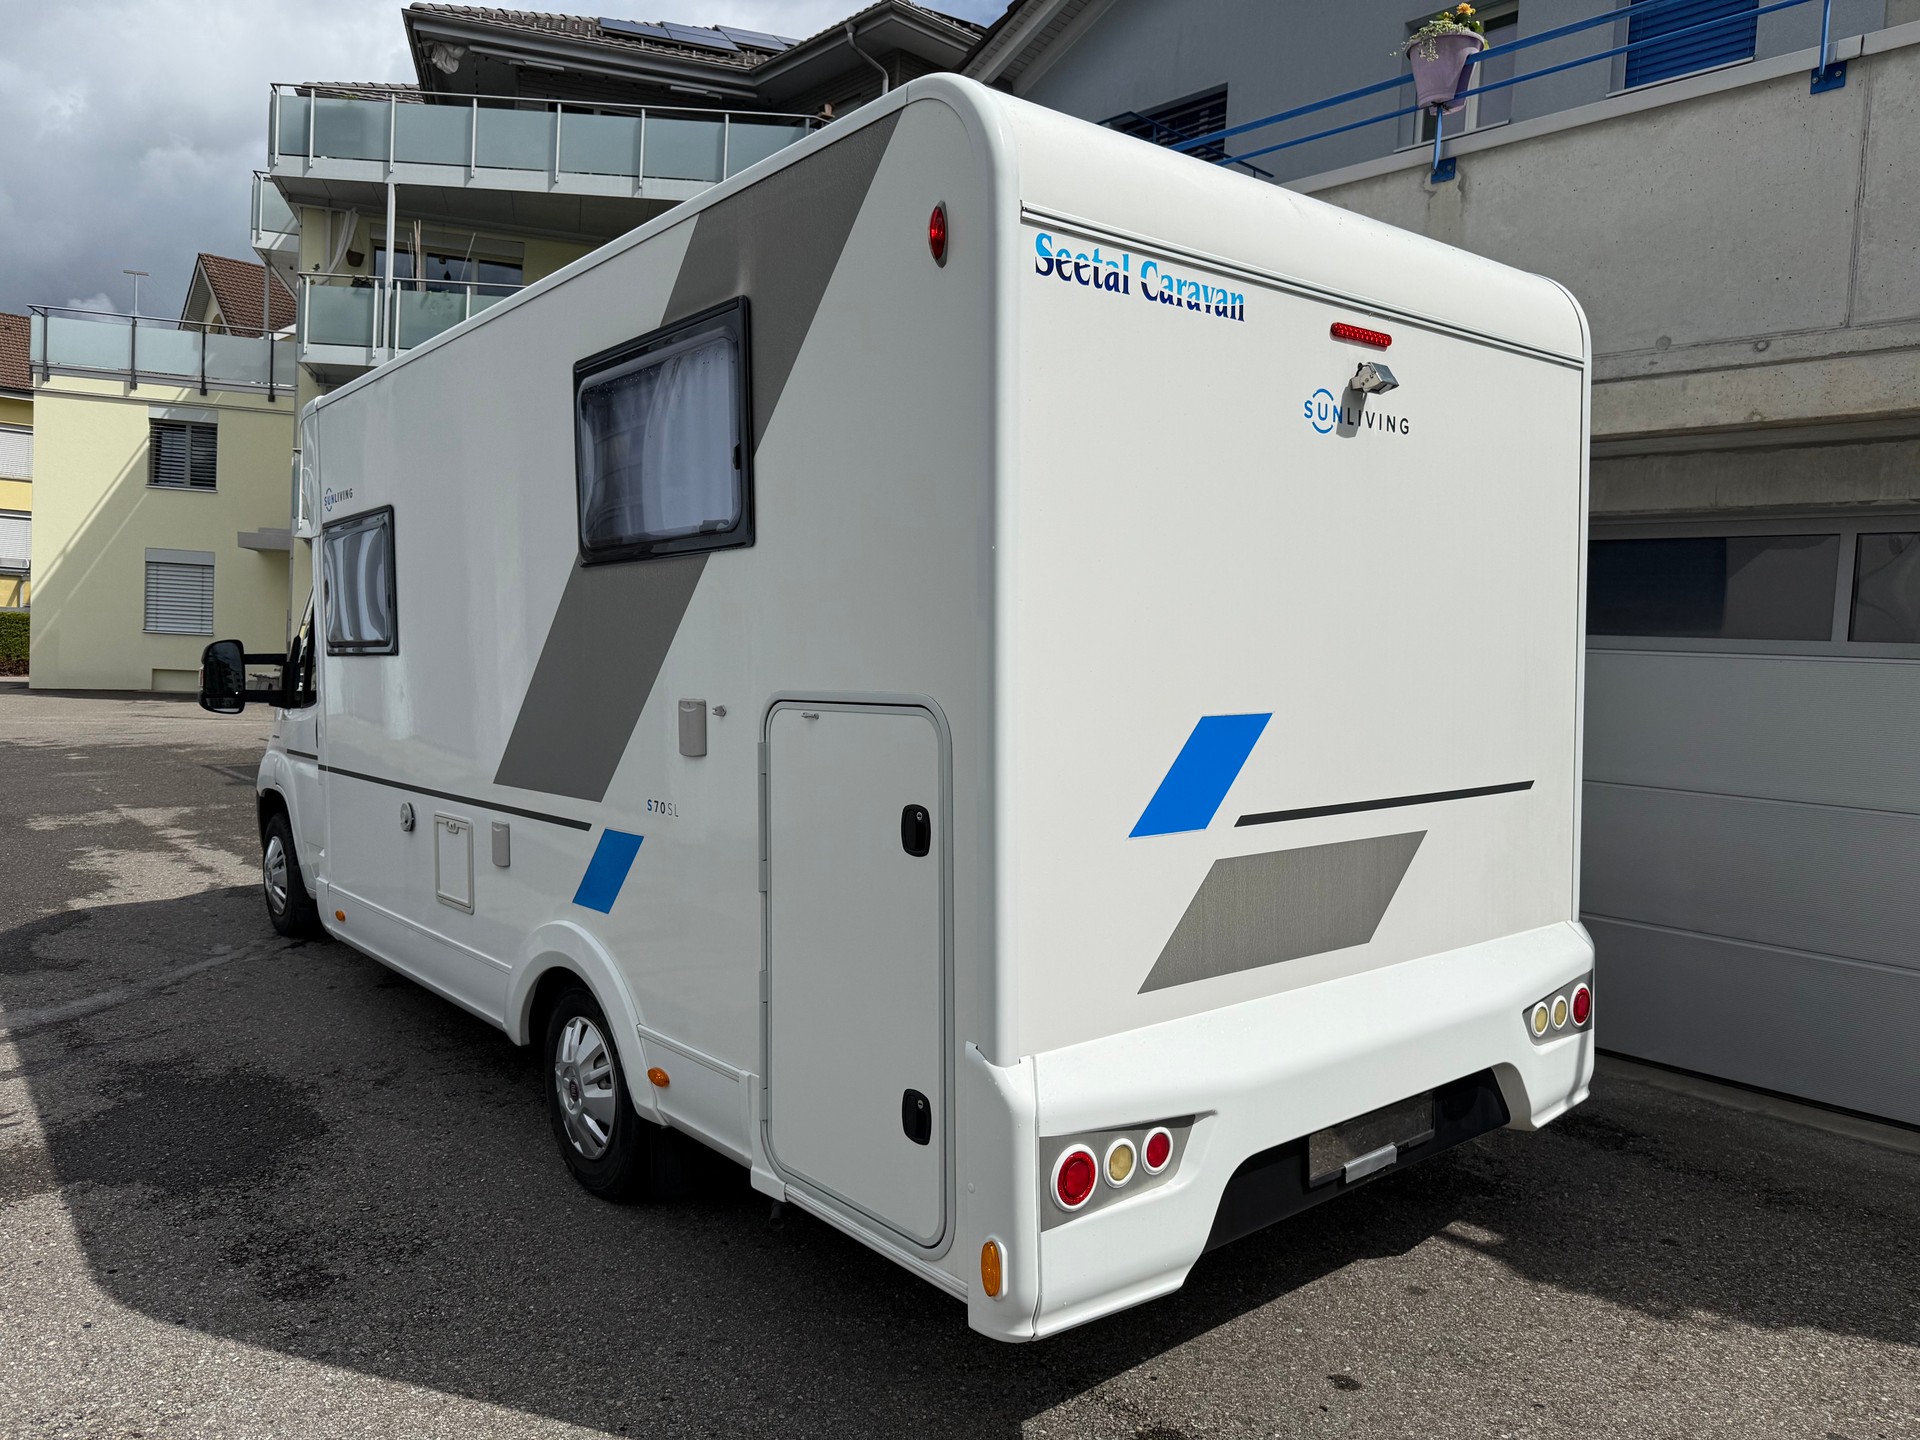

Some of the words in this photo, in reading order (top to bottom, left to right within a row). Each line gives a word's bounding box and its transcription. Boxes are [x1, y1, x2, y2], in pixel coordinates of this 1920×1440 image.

[1035, 232, 1130, 295] Seetal
[1140, 260, 1245, 322] Caravan
[1303, 399, 1410, 435] SUNLIVING
[324, 488, 353, 507] SUNLIVING
